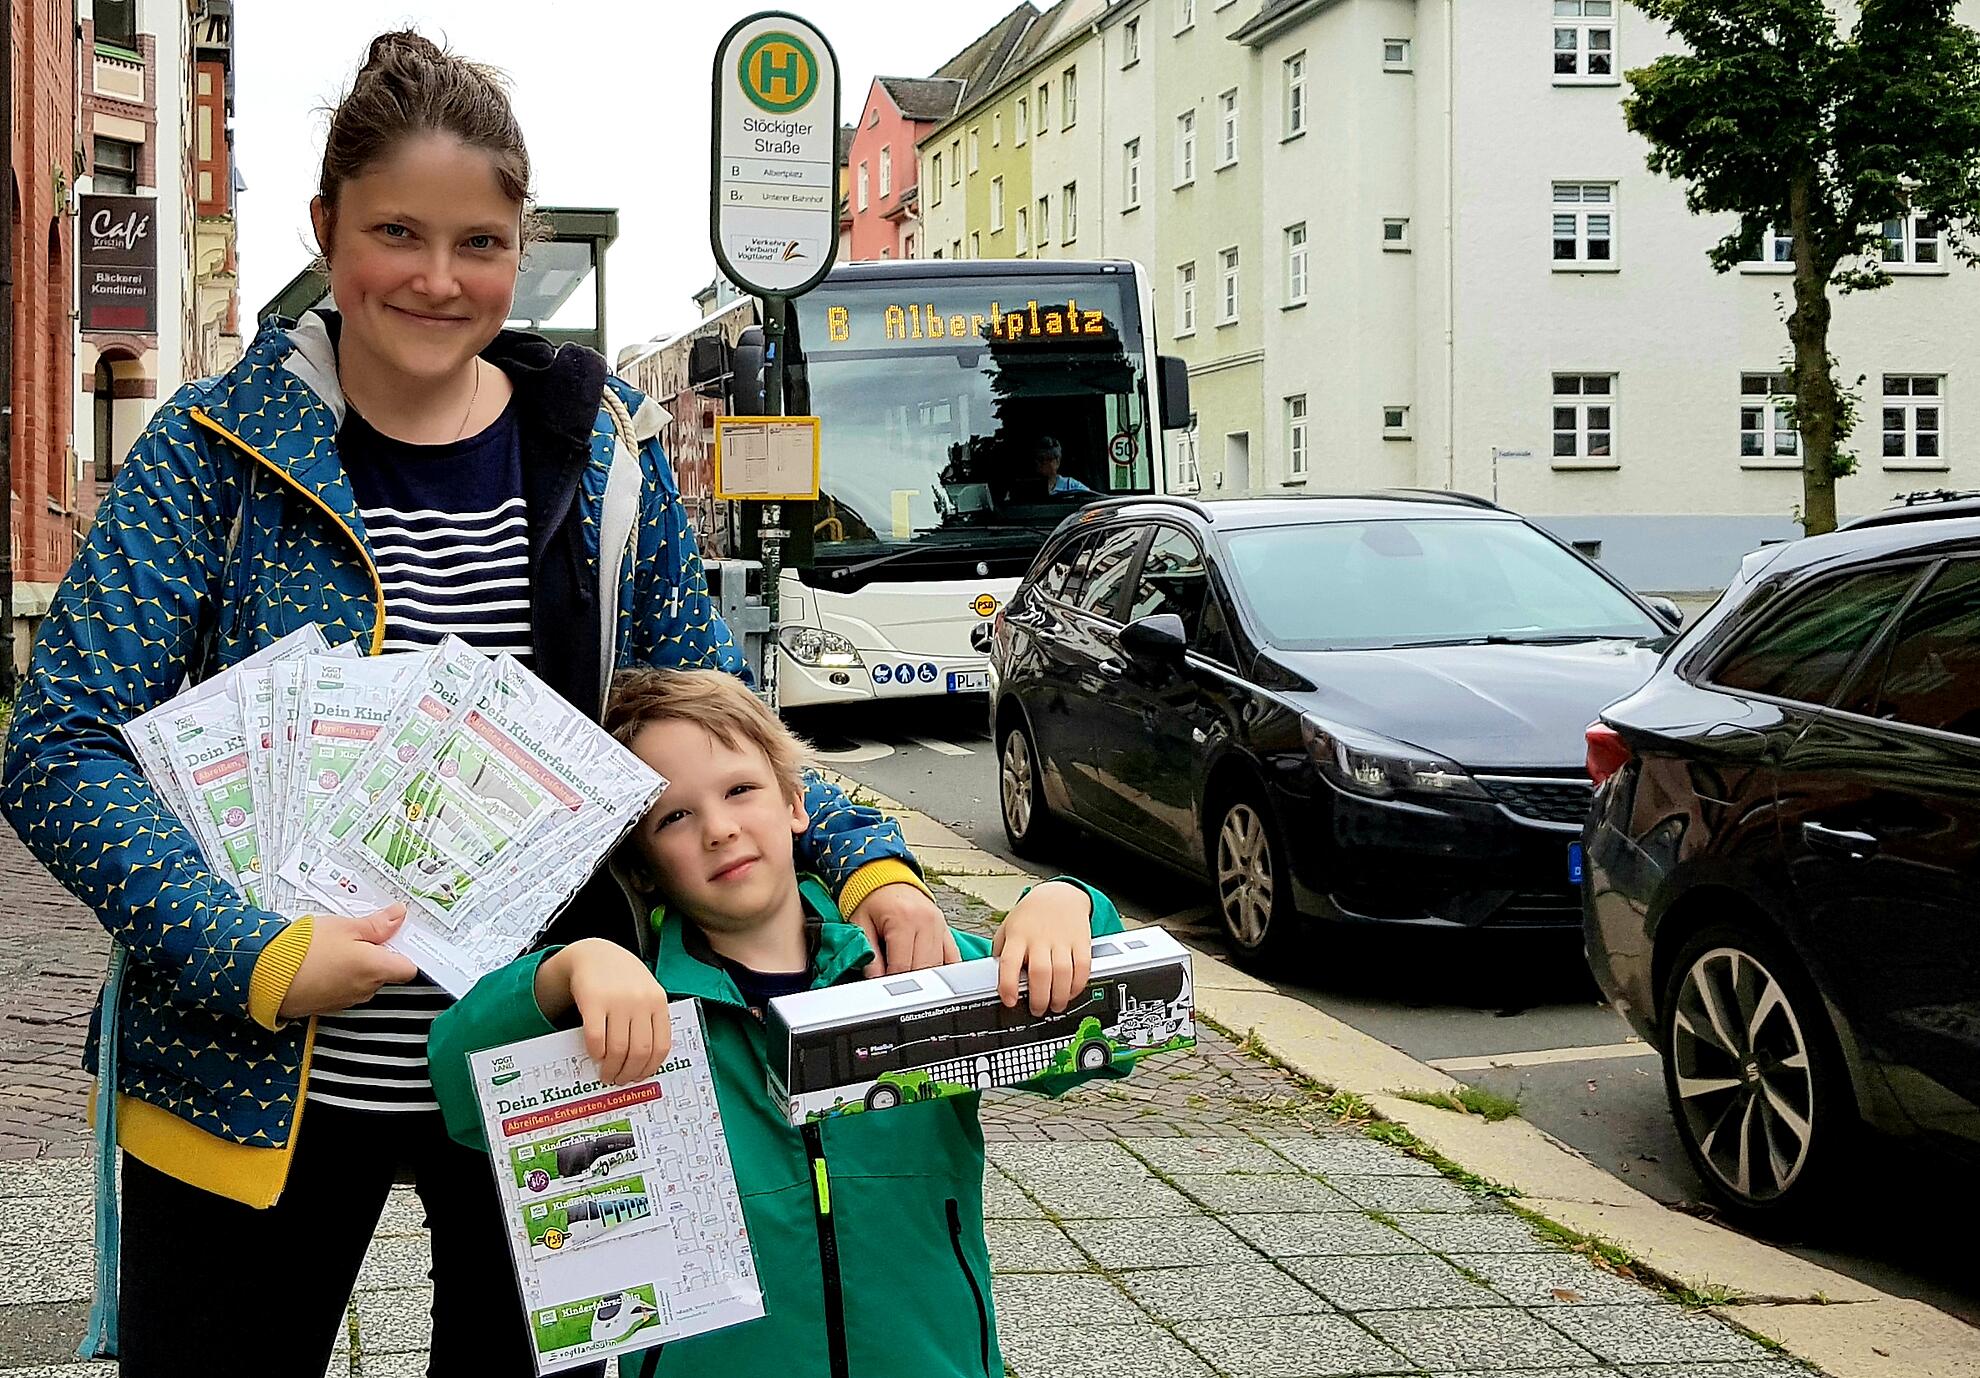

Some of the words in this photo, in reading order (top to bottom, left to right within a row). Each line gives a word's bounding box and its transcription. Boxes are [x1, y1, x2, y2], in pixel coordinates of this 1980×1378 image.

[761, 50, 798, 95] H
[743, 118, 813, 137] Stöckigter
[755, 138, 801, 154] Straße
[732, 165, 740, 176] B
[763, 169, 803, 178] Albertplatz
[762, 193, 790, 202] Unterer
[792, 194, 824, 203] Bahnhof
[90, 209, 149, 250] Café
[93, 238, 124, 248] Kristin
[745, 245, 778, 254] Verbund
[738, 252, 773, 260] Vogtland
[96, 272, 142, 284] Bäckerei
[91, 284, 147, 296] Konditorei
[827, 305, 849, 341] B
[884, 299, 1104, 341] Albertplatz
[313, 702, 351, 718] Dein
[185, 745, 225, 768] Dein
[476, 695, 508, 727] Dein
[507, 722, 618, 816] Kinderfahrschein
[491, 1056, 513, 1066] VOGT
[493, 1063, 515, 1073] LAND
[497, 1096, 539, 1115] Dein
[506, 1113, 553, 1131] Abreißen,
[554, 1101, 607, 1119] Entwerten,
[606, 1086, 657, 1106] Losfahren!
[540, 1128, 617, 1152] Kinderfahrschein
[561, 1293, 641, 1318] Kinderfahrschein
